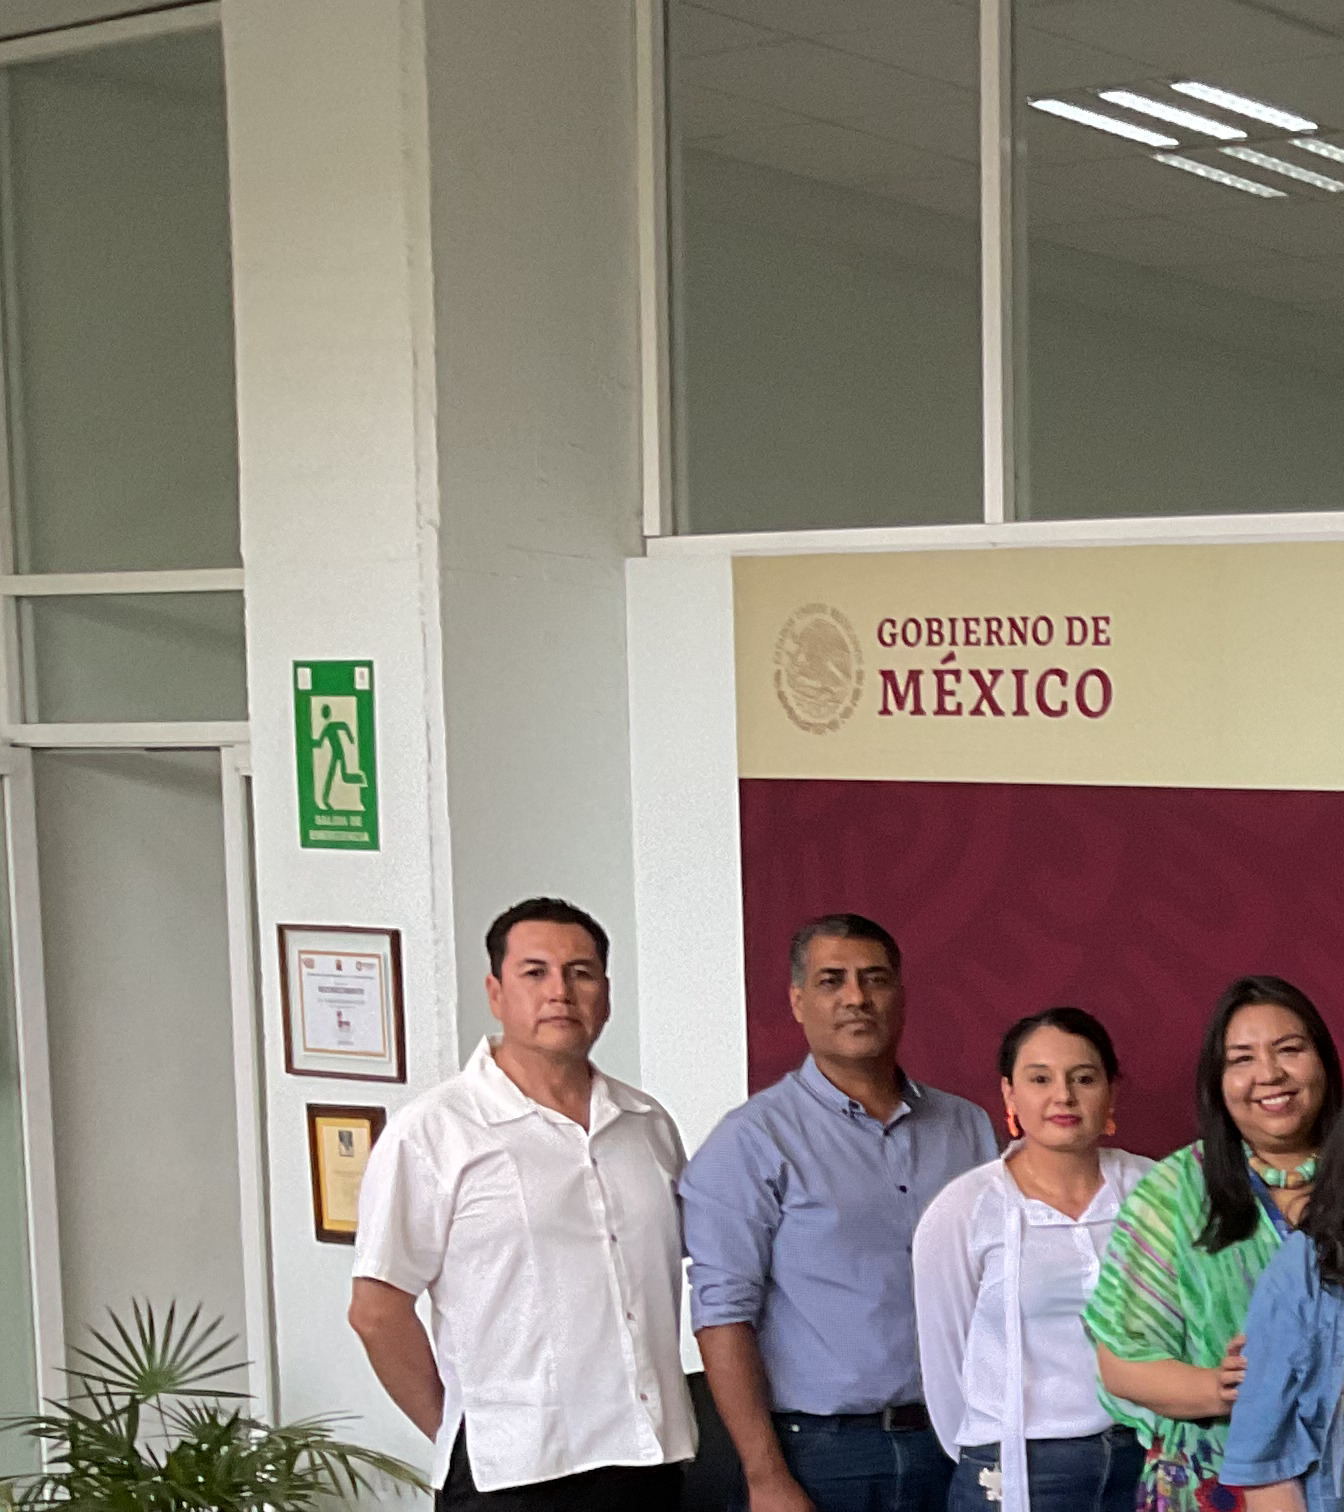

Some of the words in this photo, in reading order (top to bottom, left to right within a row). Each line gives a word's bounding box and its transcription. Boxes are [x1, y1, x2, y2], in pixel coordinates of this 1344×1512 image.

[877, 615, 1055, 647] GOBIERNO
[1065, 615, 1111, 647] DE
[877, 650, 1113, 719] MÉXICO
